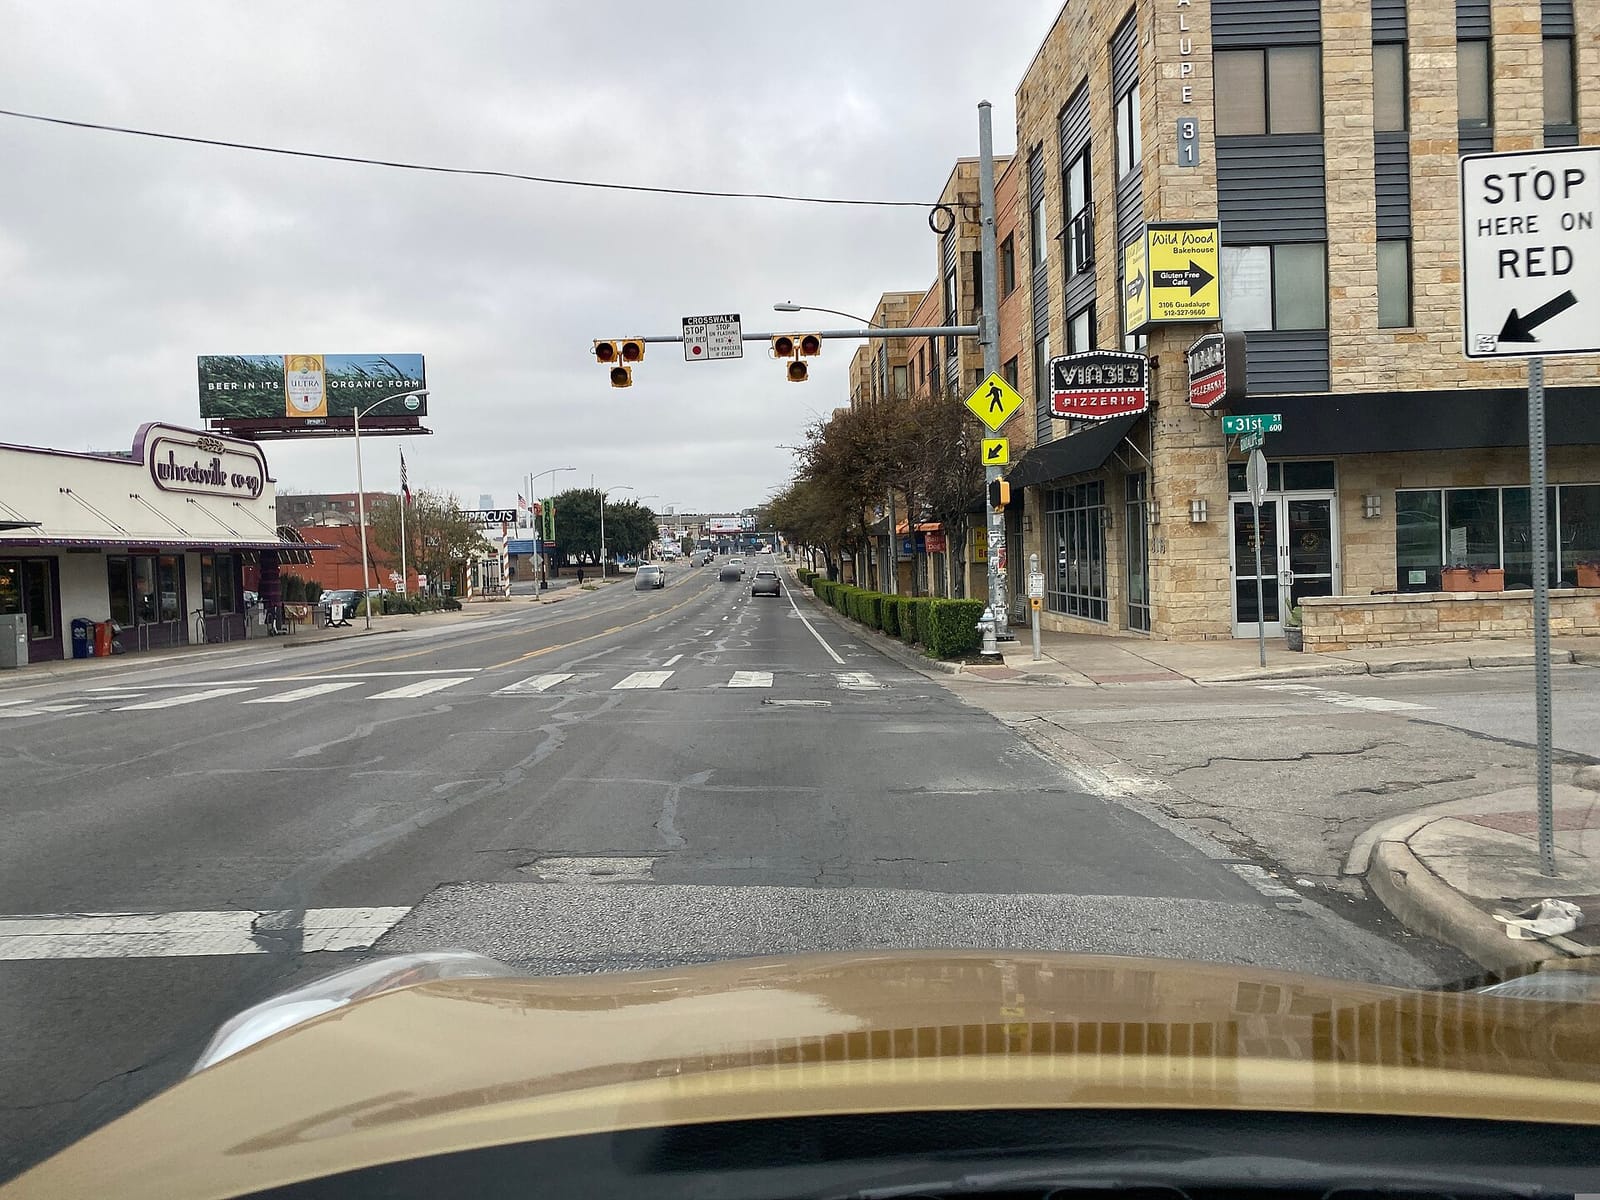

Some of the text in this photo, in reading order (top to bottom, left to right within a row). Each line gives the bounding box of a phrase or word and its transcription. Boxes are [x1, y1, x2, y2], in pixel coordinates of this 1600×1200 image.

[1183, 122, 1195, 162] 31
[1483, 168, 1586, 205] STOP
[1478, 211, 1593, 237] HERE ON
[1152, 231, 1214, 247] Wild Wood
[1173, 246, 1215, 254] Bakehouse
[1498, 245, 1574, 279] RED
[687, 316, 735, 325] CROSSWALK
[685, 326, 705, 335] STOP
[208, 380, 419, 390] BEER IN ITS ORGANIC FORM
[291, 380, 319, 388] ULTRA
[1062, 395, 1137, 407] PIZZERIA
[1235, 417, 1263, 431] 31st
[1272, 414, 1282, 422] ST
[458, 510, 513, 522] UPERCUTS
